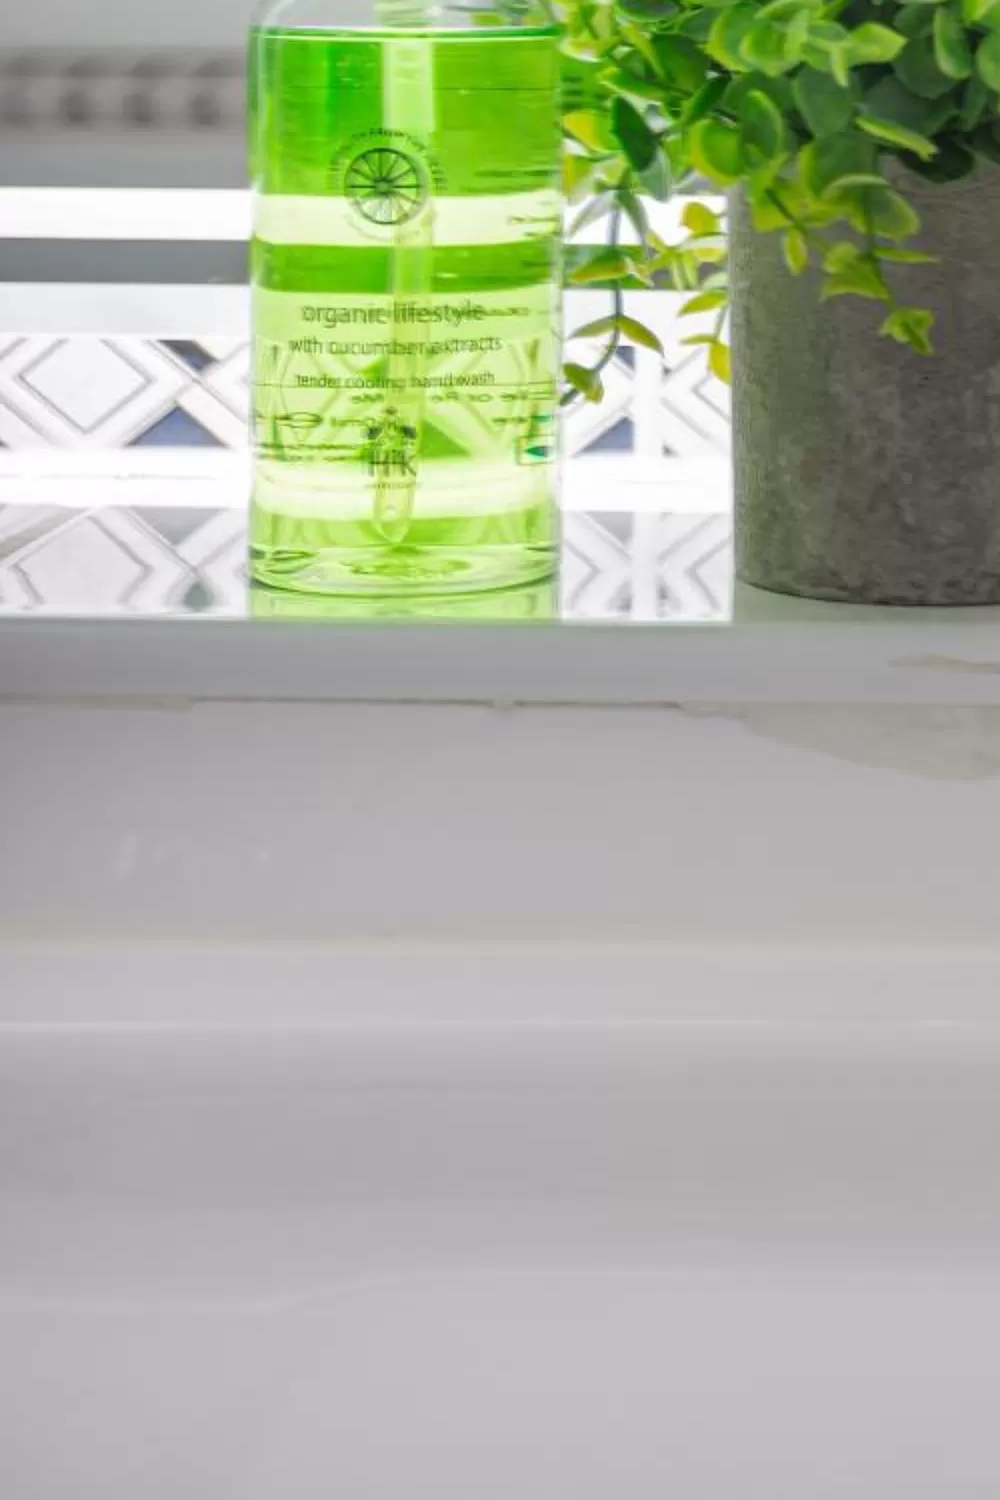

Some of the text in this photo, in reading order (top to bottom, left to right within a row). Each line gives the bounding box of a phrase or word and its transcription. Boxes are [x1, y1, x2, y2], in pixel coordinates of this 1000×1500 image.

[302, 303, 389, 329] organic
[393, 300, 485, 327] lifestyle
[288, 336, 322, 355] with
[328, 338, 425, 356] cucumber
